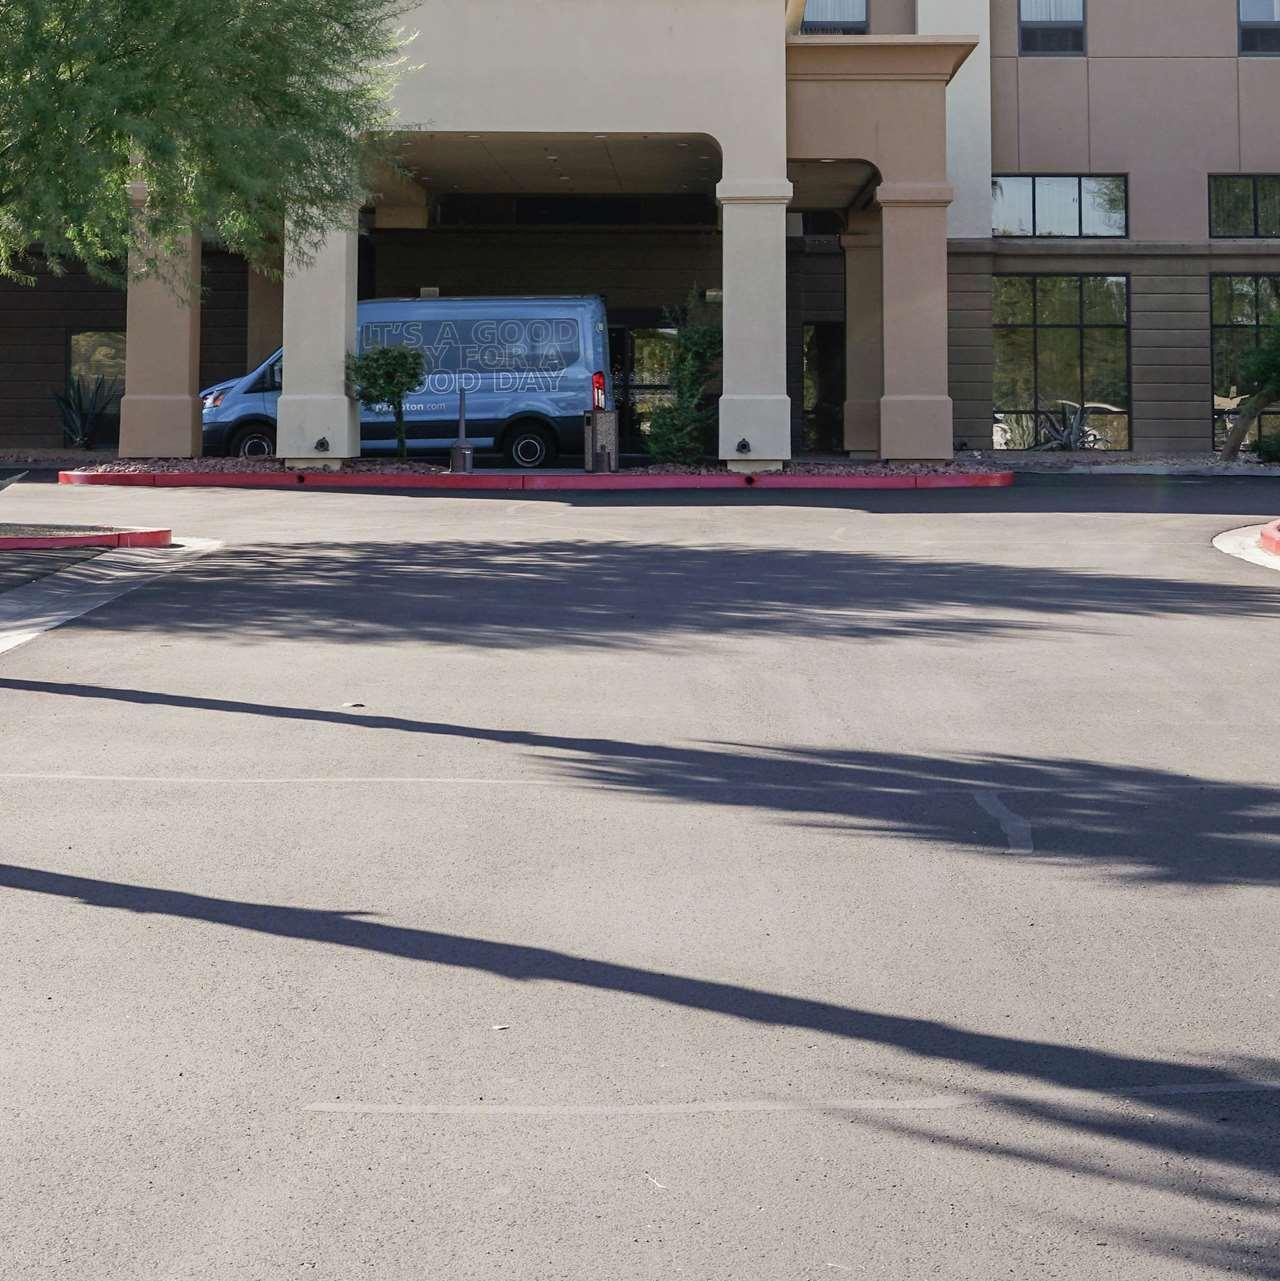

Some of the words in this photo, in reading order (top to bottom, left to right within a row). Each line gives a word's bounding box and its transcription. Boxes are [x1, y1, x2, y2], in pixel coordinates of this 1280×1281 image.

[363, 321, 424, 348] IT'S
[434, 321, 460, 347] A
[471, 320, 579, 346] GOOD
[460, 343, 530, 369] FOR
[540, 343, 566, 369] A
[493, 368, 564, 393] DAY
